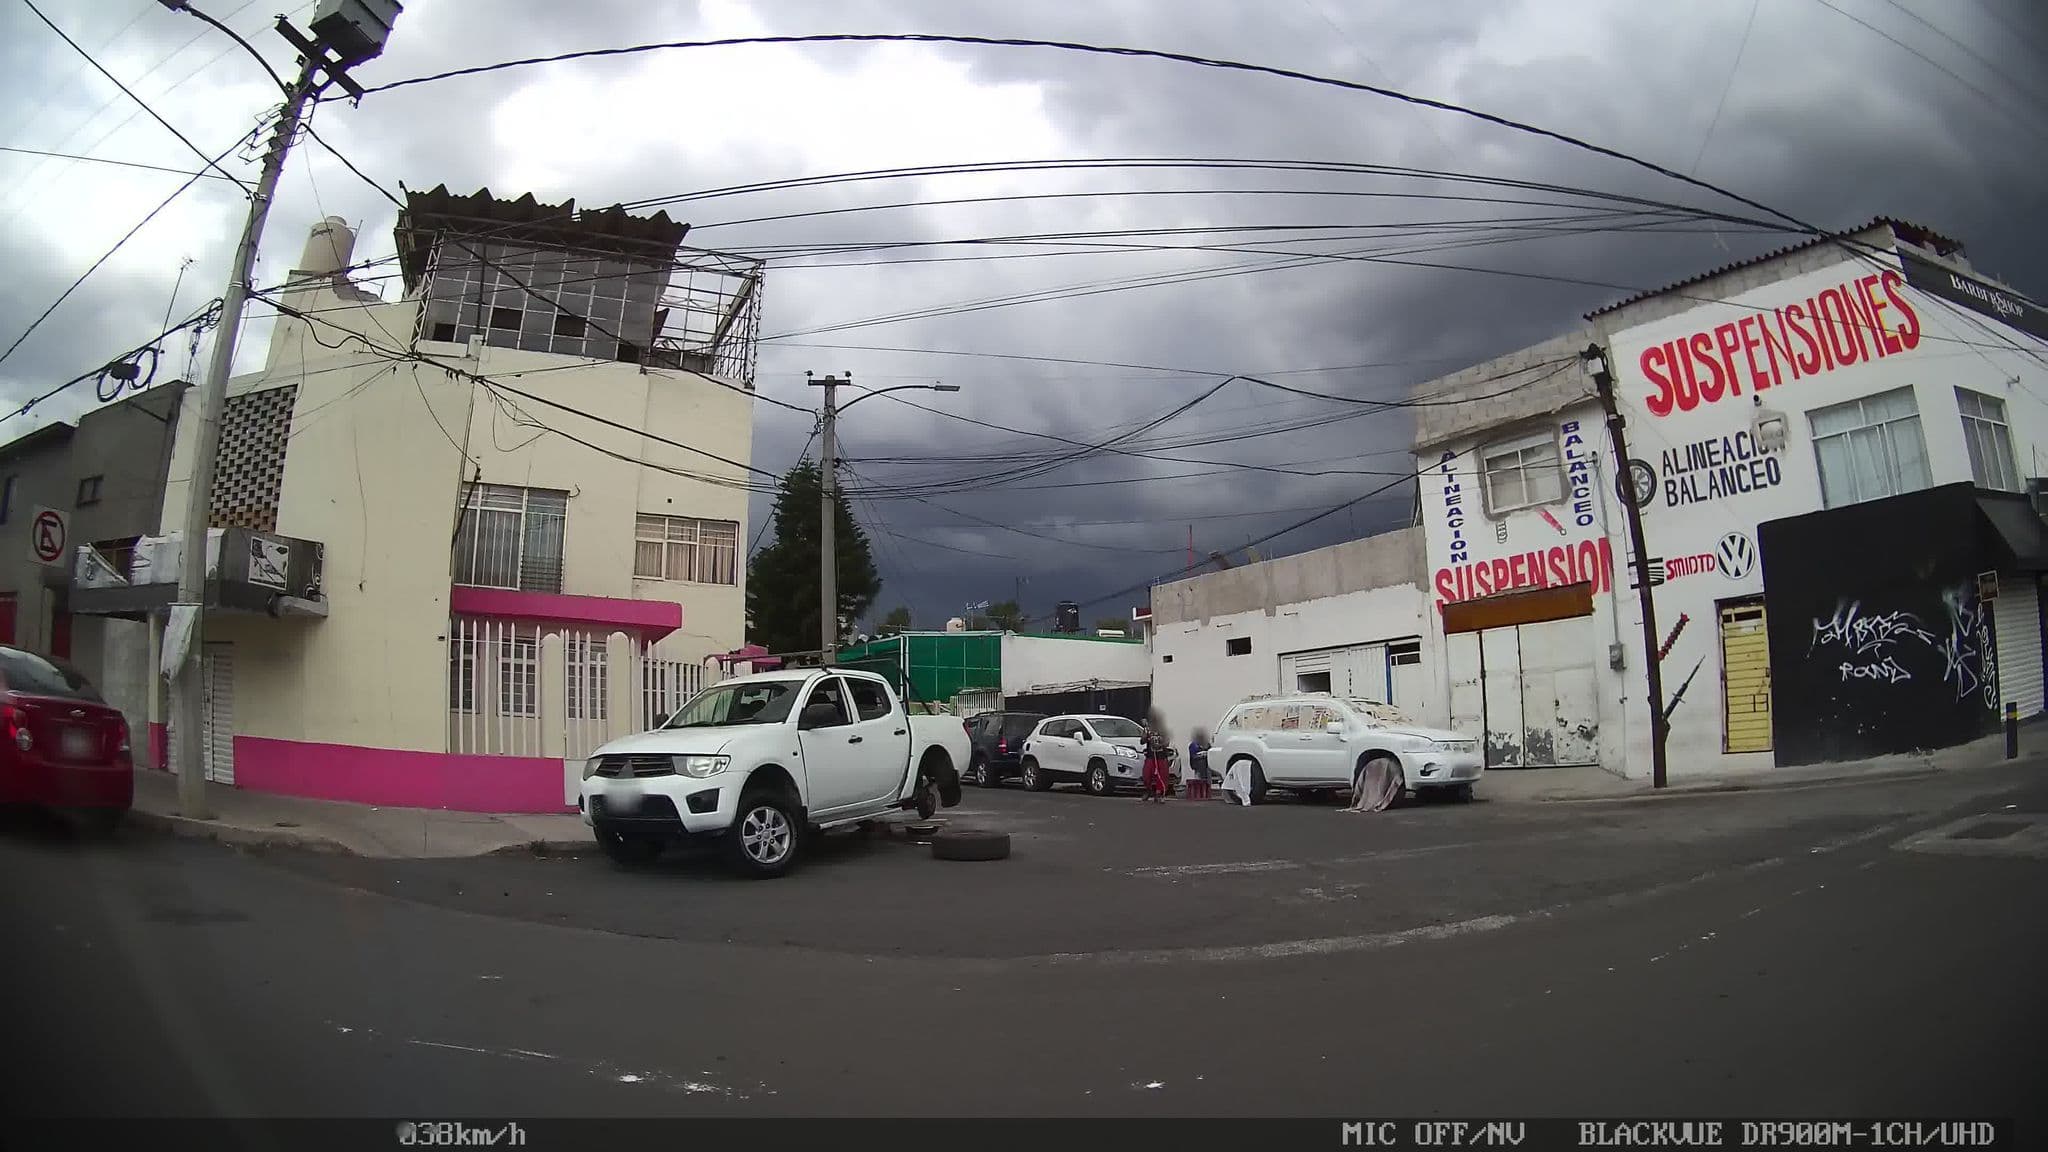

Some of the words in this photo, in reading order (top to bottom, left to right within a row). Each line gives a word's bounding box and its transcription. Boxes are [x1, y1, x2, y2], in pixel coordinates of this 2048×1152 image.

[1640, 269, 1921, 417] SUSPENSIONES
[1441, 449, 1468, 563] ALINEACION
[1562, 420, 1594, 526] BALANCEO
[1662, 431, 1785, 477] ALINEACI
[1664, 456, 1782, 507] BALANCEO
